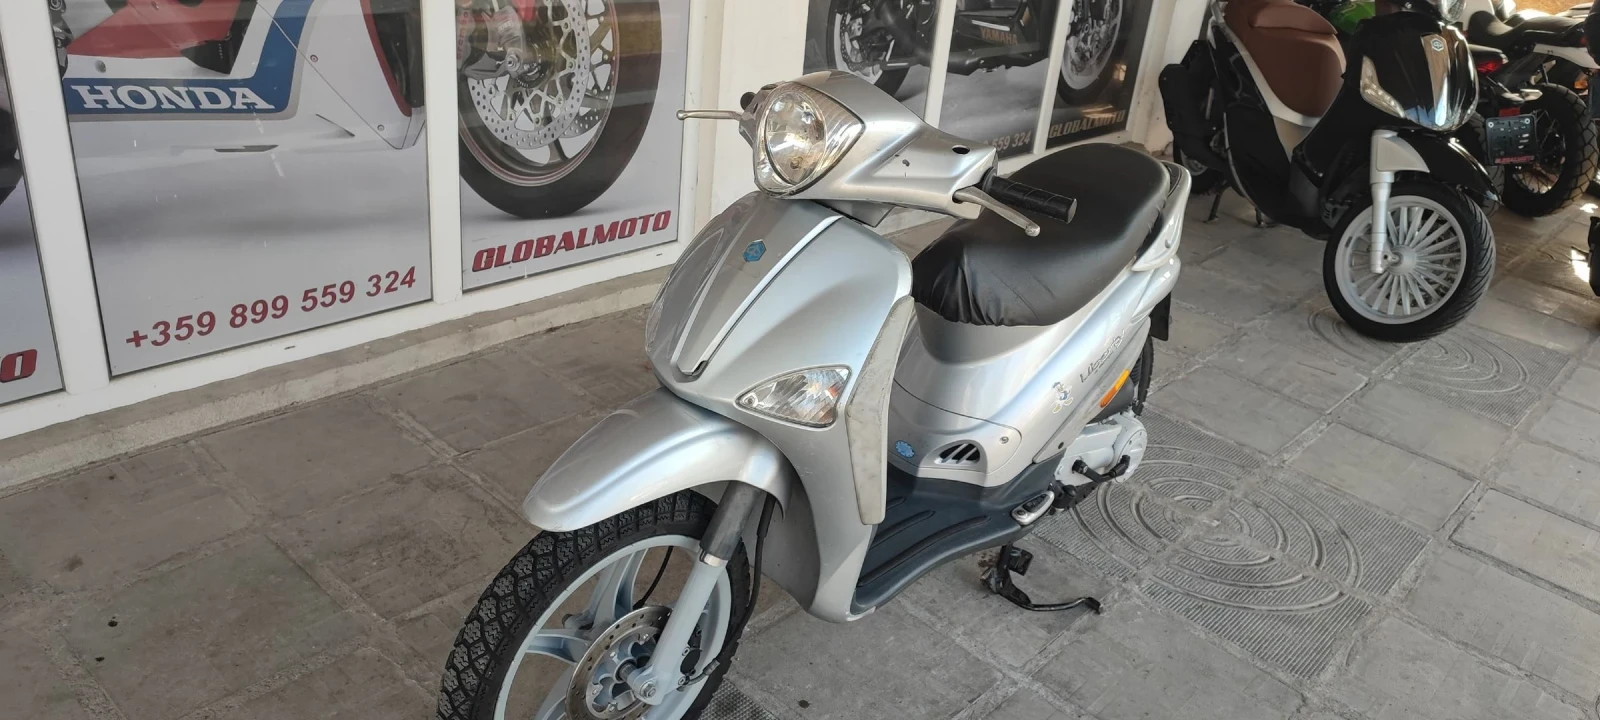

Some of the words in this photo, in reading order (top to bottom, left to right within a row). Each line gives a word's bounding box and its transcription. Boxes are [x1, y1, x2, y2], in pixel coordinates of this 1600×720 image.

[980, 27, 1018, 46] YAMAHA
[70, 85, 276, 110] HONDA
[1012, 130, 1032, 148] 324
[472, 210, 671, 272] GLOBALMOTO
[125, 311, 216, 348] +359
[229, 295, 289, 329] 899
[301, 280, 356, 312] 559
[366, 266, 416, 297] 324
